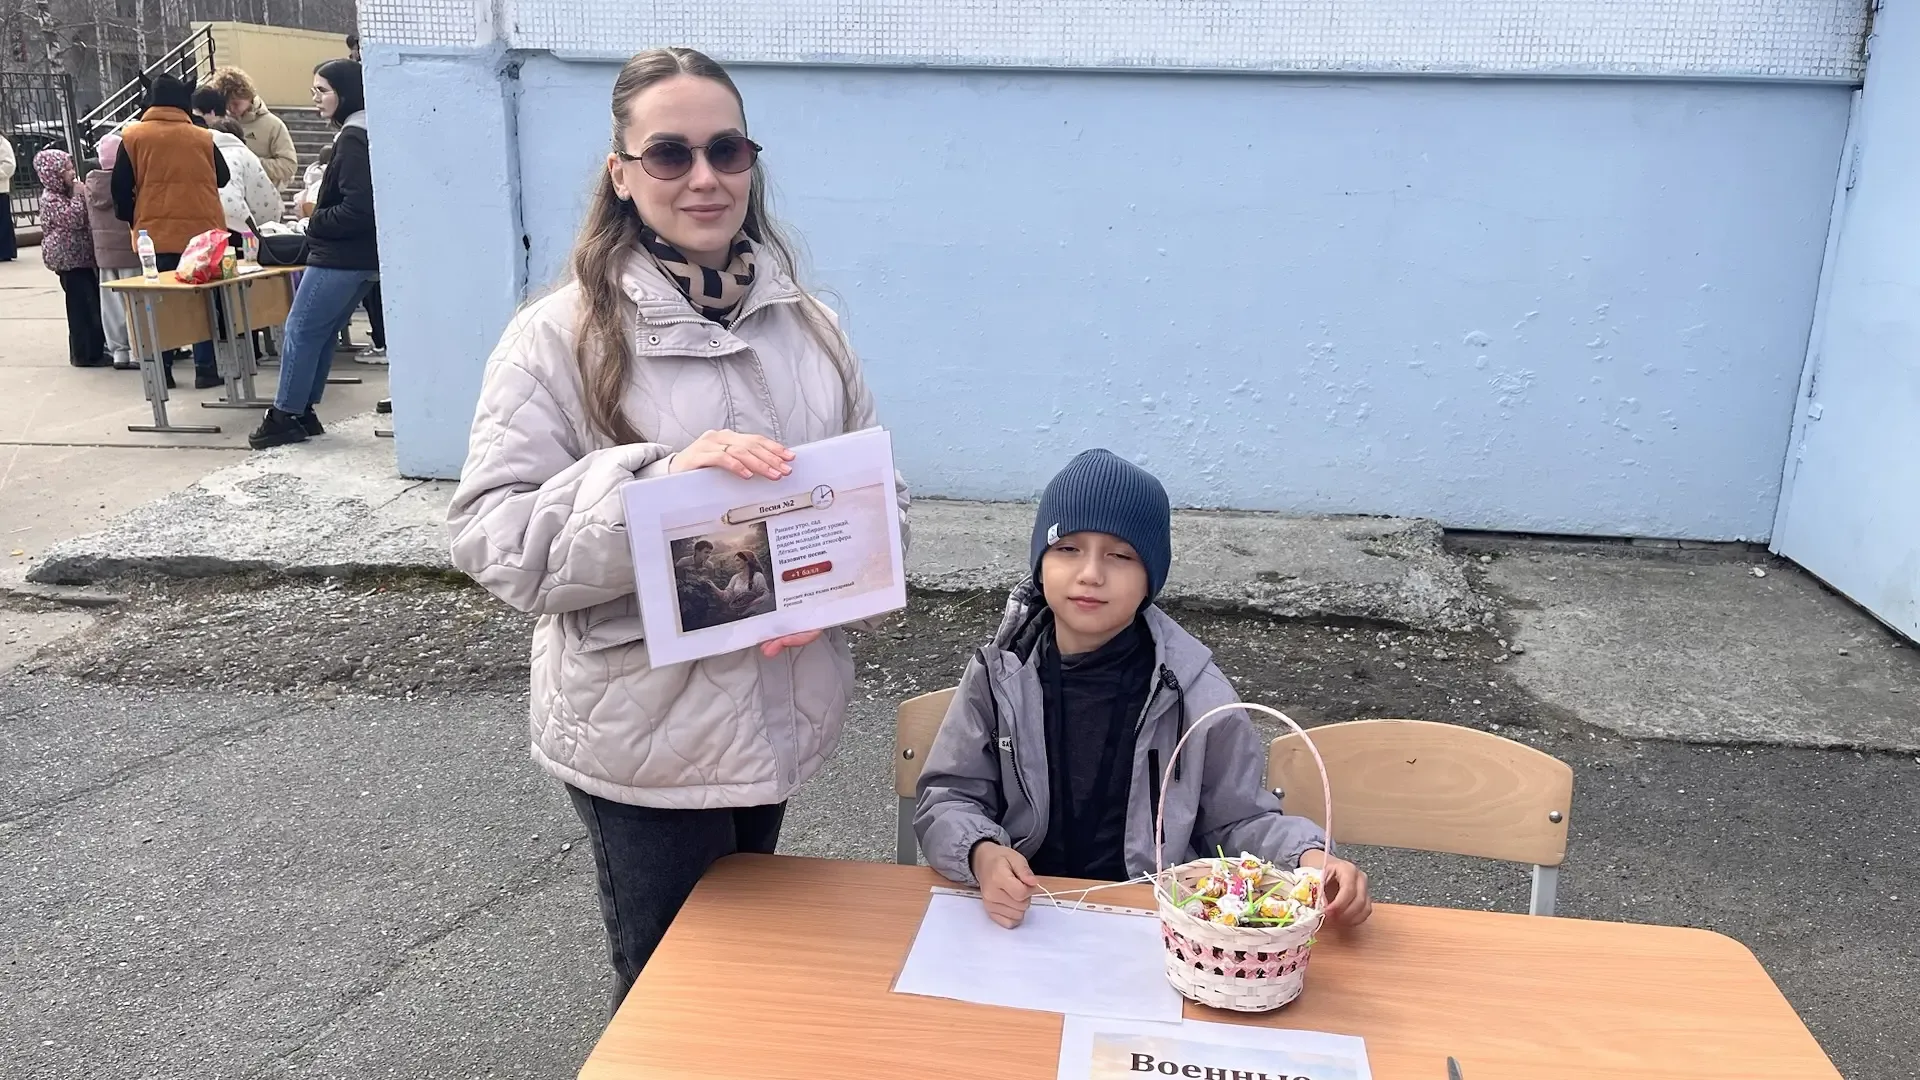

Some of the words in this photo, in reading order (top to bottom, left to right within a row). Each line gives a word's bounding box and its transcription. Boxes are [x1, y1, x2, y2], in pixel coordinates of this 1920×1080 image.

[759, 504, 781, 513] Песня
[782, 499, 795, 509] №2
[775, 532, 801, 542] Девушка
[801, 525, 827, 535] собирает
[778, 555, 807, 565] Назовите
[791, 570, 800, 578] +1
[801, 567, 819, 576] балл
[1130, 1052, 1311, 1080] Военны
